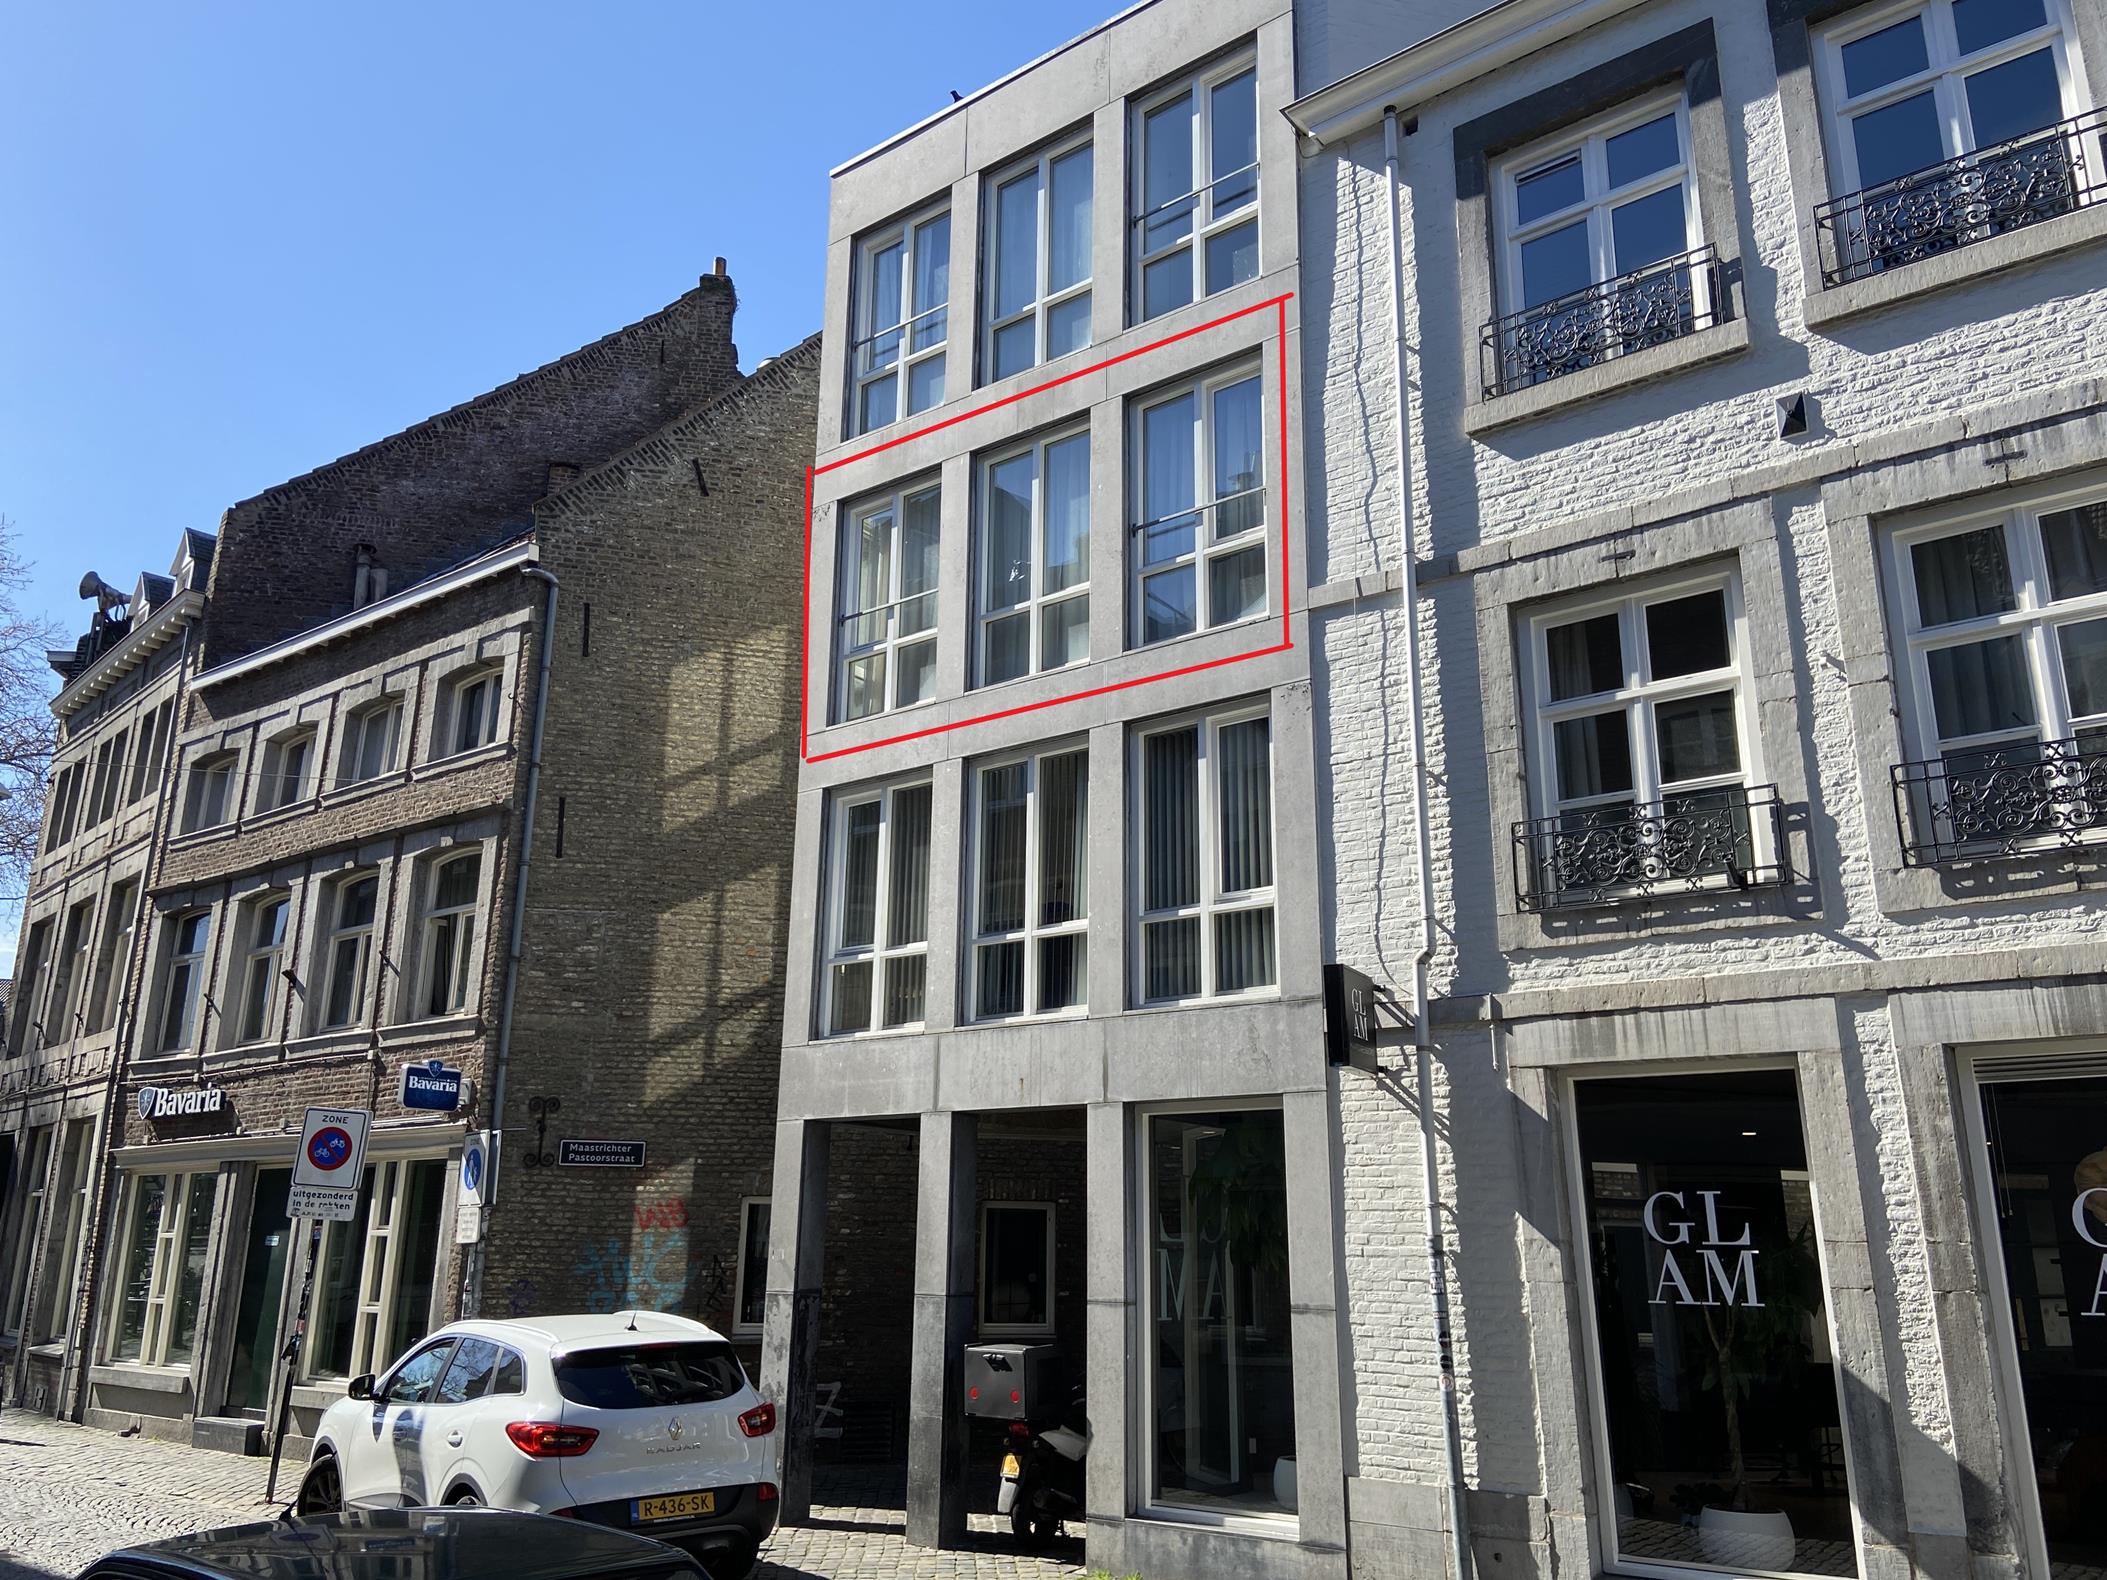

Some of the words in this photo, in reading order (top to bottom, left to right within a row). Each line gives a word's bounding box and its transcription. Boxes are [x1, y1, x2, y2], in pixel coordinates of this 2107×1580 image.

[1351, 988, 1366, 1016] GL
[1353, 1014, 1369, 1041] AM
[408, 1075, 458, 1093] Bavaria
[154, 1082, 222, 1117] Bavaria
[321, 1114, 349, 1125] ZONE
[568, 1153, 636, 1163] Pastoorstraat
[569, 1143, 632, 1153] Maastrichter
[292, 1189, 354, 1201] uitgezonderd
[292, 1199, 302, 1208] in
[304, 1200, 316, 1209] de
[1643, 1190, 1751, 1246] GL
[1647, 1248, 1766, 1308] AM
[643, 1495, 710, 1518] R-436-SK
